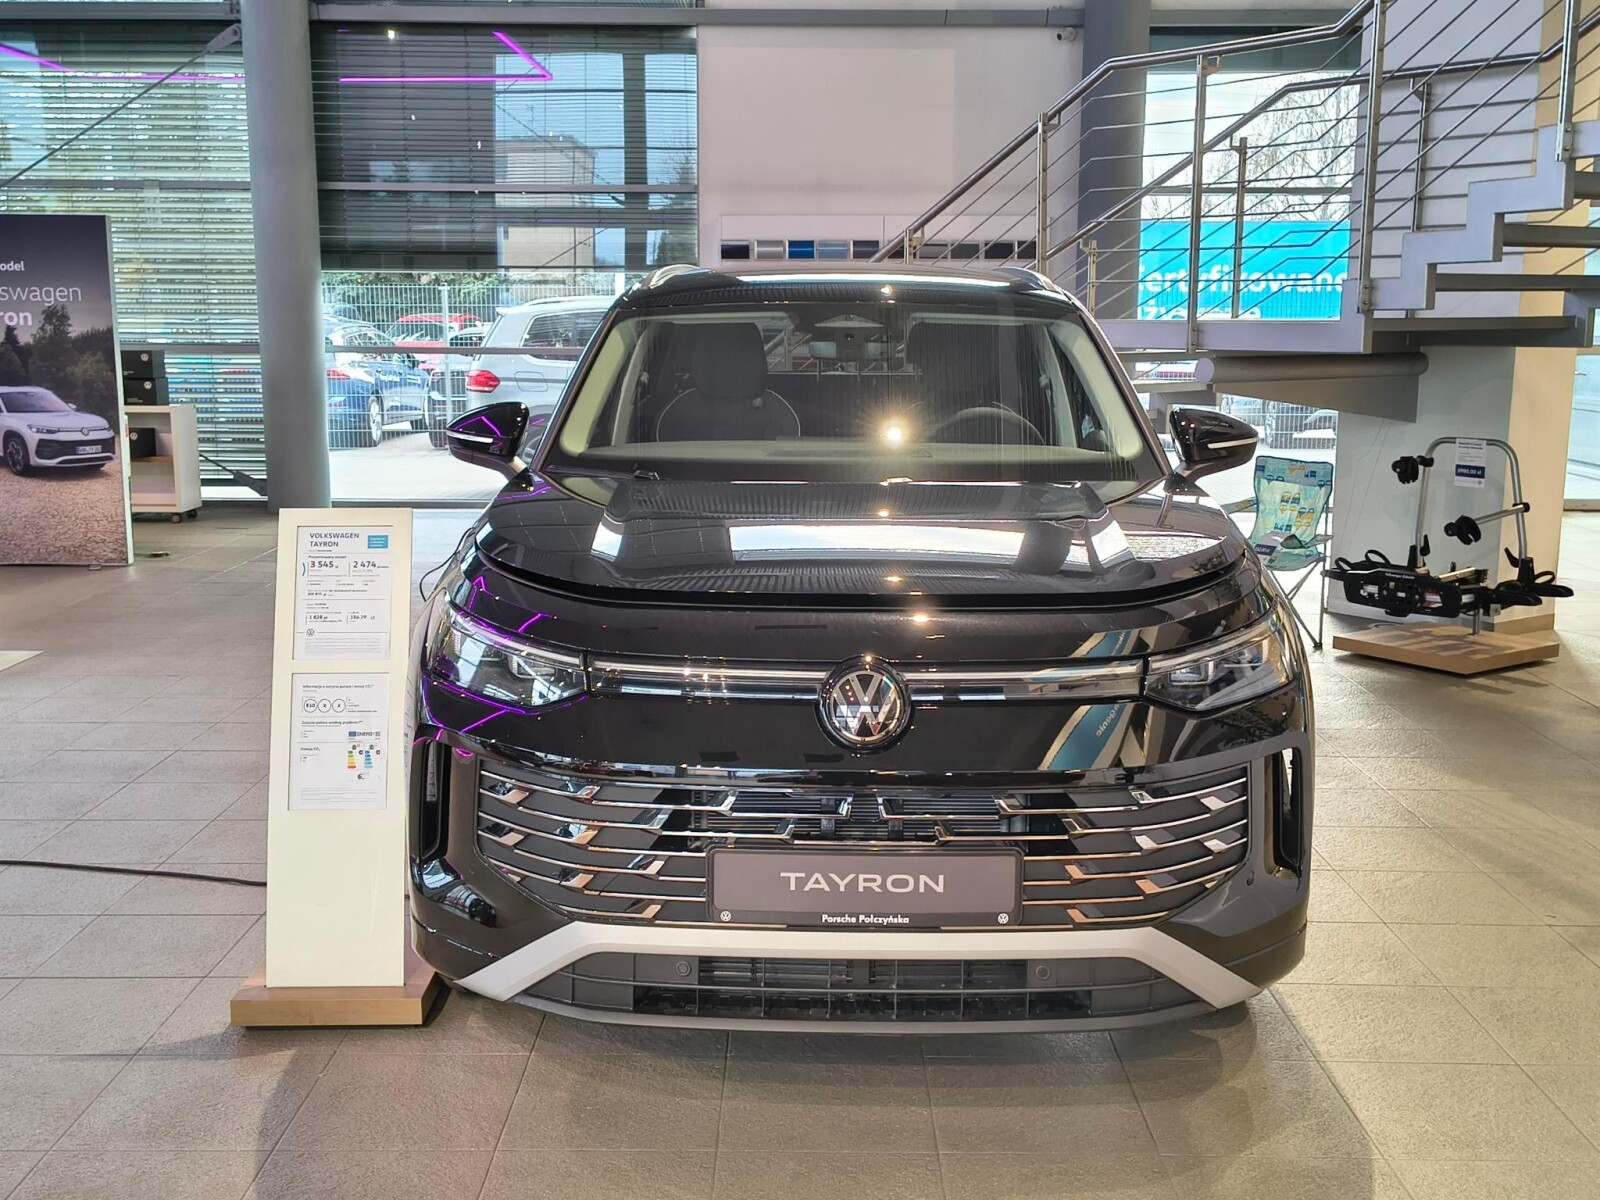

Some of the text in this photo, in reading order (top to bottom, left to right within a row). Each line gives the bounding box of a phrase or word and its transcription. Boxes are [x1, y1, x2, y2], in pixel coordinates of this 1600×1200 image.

[780, 872, 945, 893] TAYRON
[821, 914, 910, 926] Porsche Połczyńska
